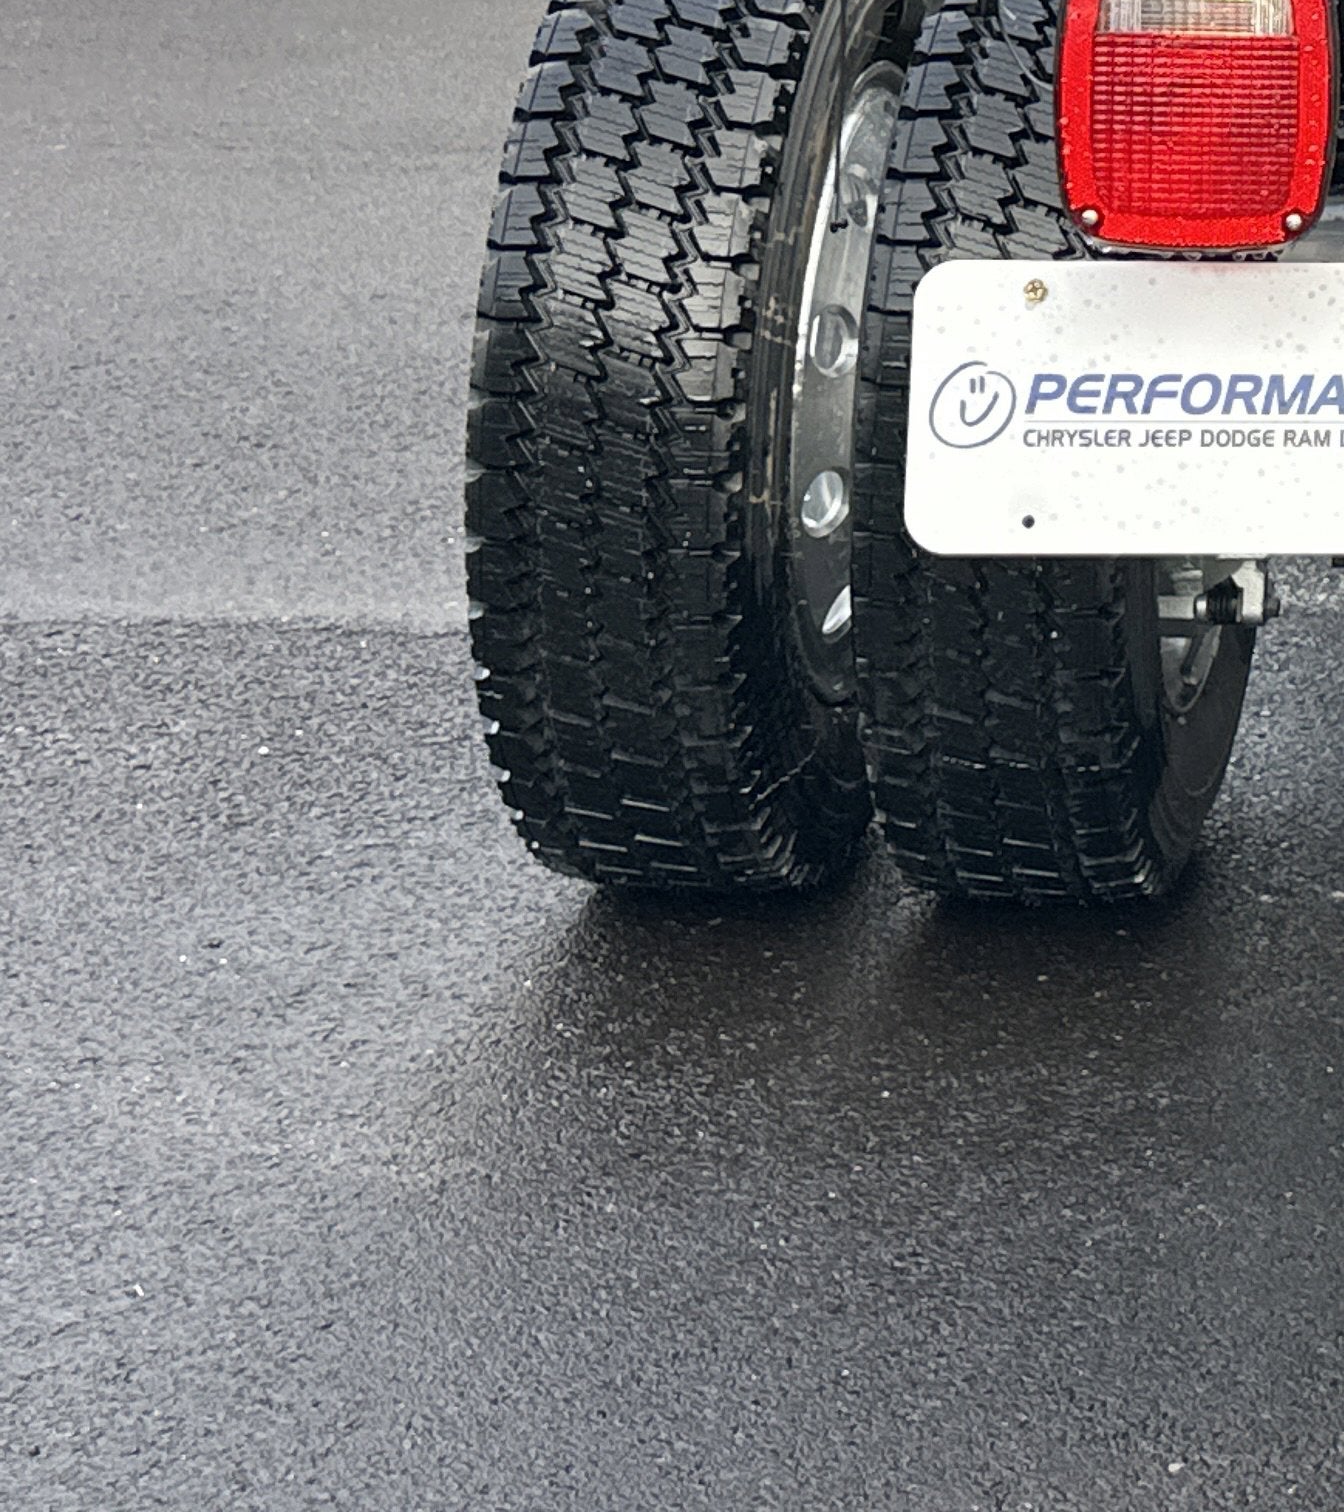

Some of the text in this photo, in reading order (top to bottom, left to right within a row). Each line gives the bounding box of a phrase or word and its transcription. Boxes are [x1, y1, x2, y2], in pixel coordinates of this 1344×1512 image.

[1023, 429, 1132, 448] CHRYSLER
[1138, 429, 1193, 448] JEEP
[1200, 429, 1275, 448] DODGE
[1283, 429, 1332, 448] RAM
